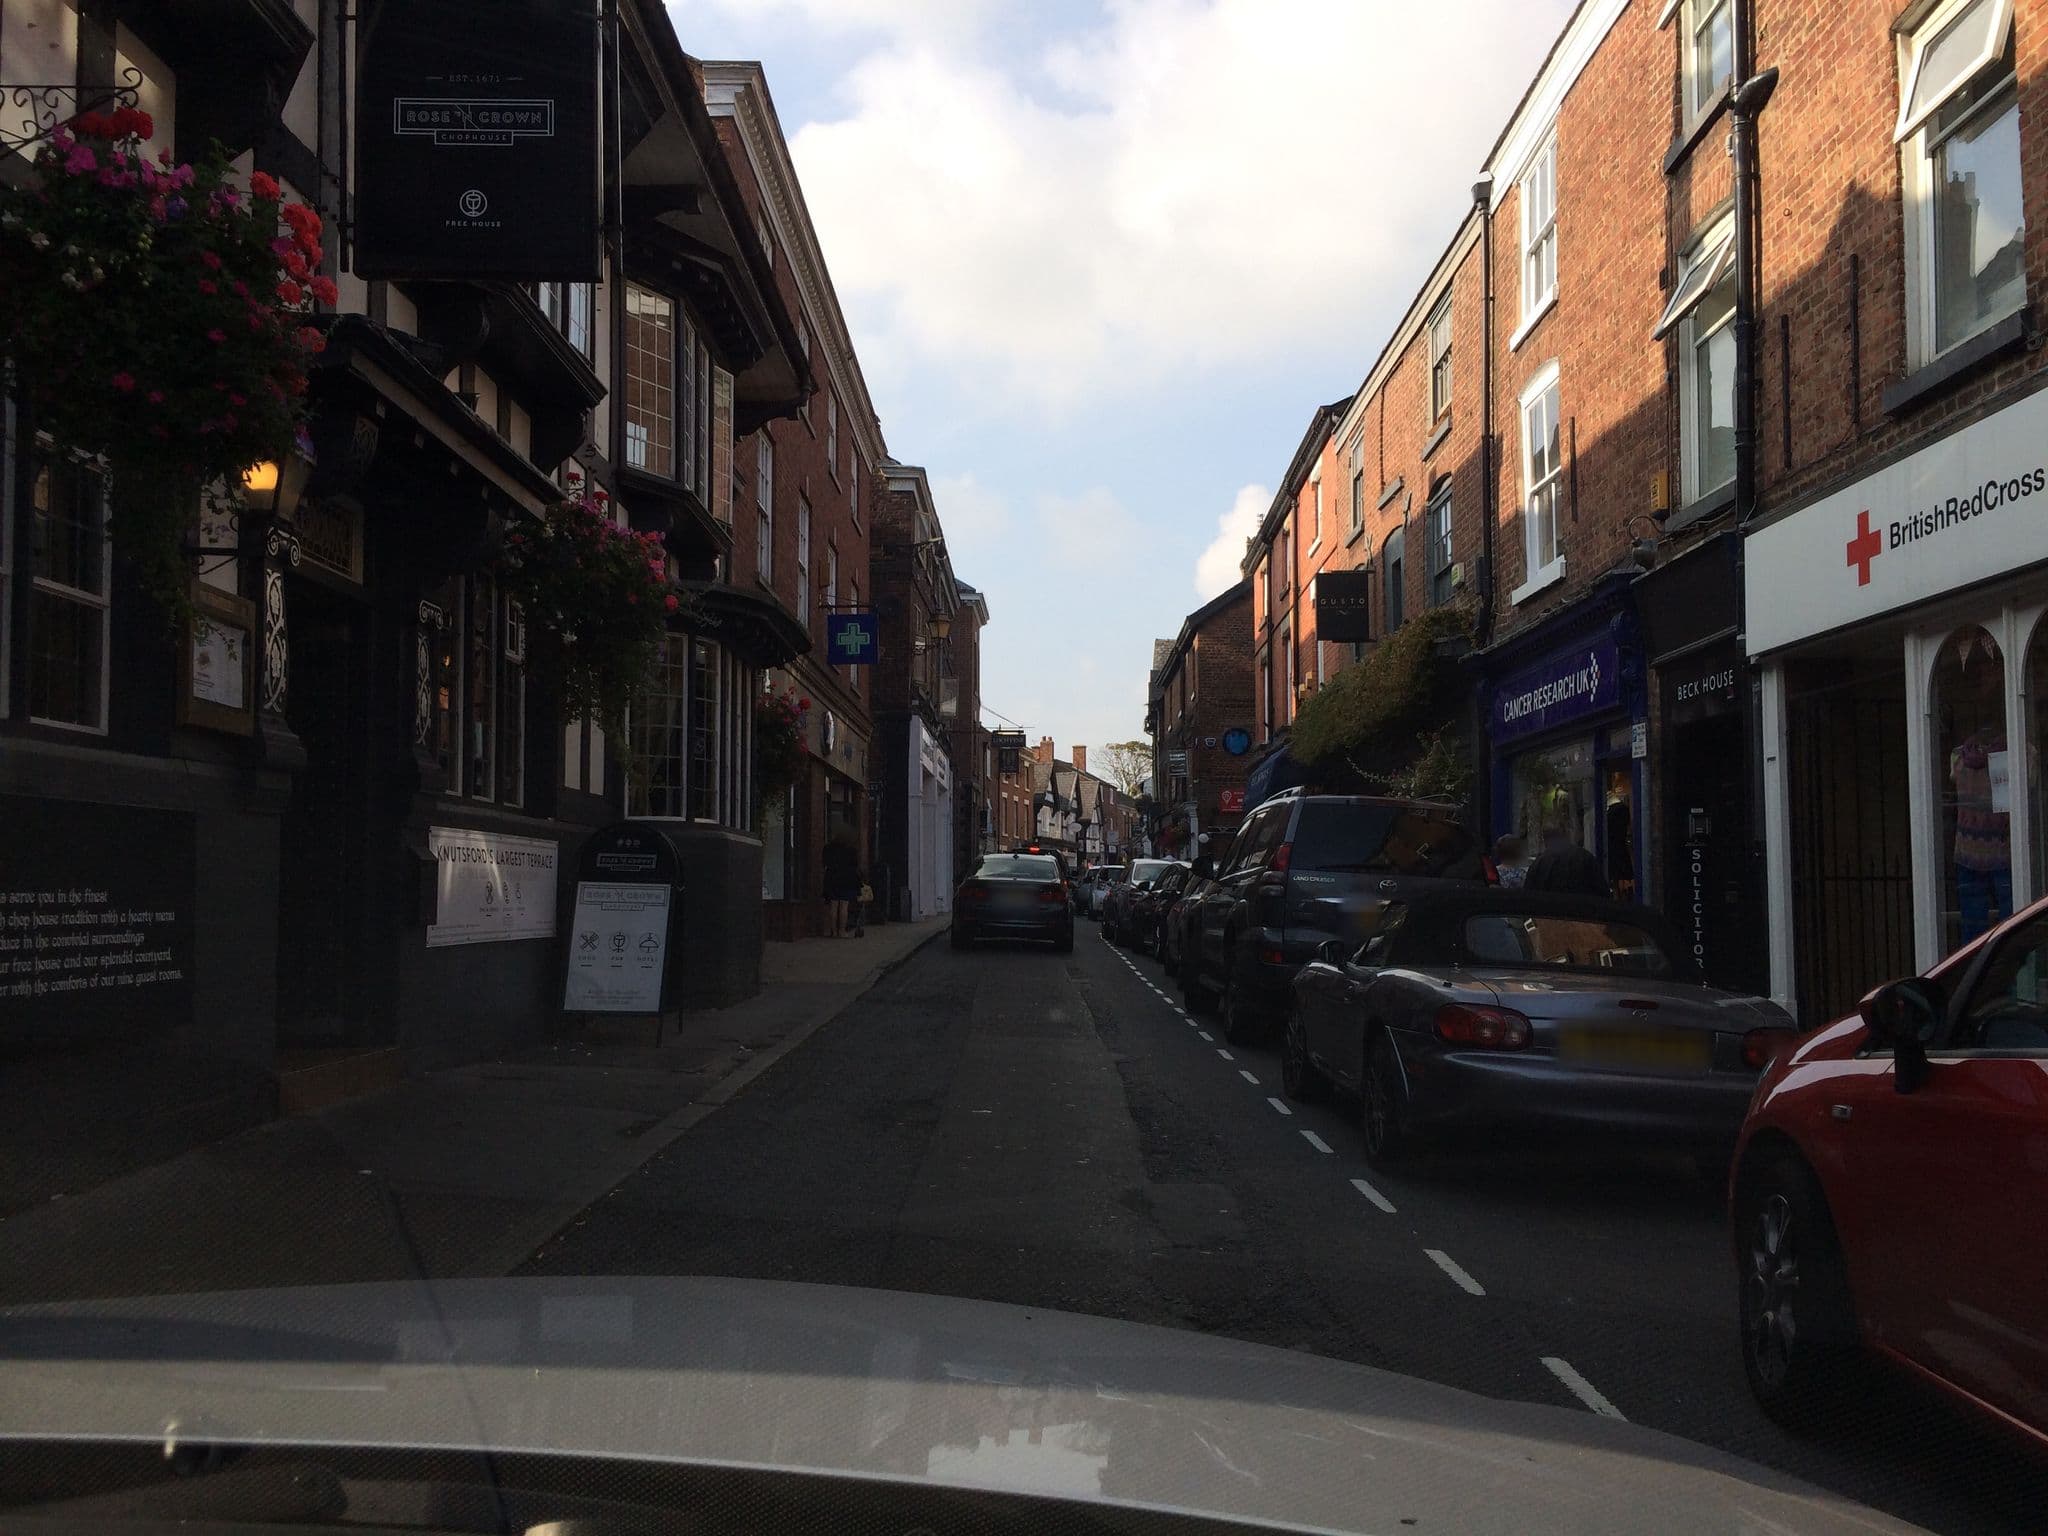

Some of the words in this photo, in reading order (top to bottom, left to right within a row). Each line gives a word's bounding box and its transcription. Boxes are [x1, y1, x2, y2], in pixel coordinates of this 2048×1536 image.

[407, 111, 450, 123] ROSE
[478, 111, 542, 124] CROWN
[441, 133, 508, 142] CHOPHOUSE
[445, 219, 468, 228] FREE
[471, 219, 502, 228] HOUSE
[1889, 467, 2046, 550] BritishRedCross
[1503, 692, 1534, 723] CANCER
[1534, 674, 1575, 711] RESEARCH
[1576, 667, 1590, 694] UK
[1676, 681, 1700, 701] BECK
[1702, 669, 1735, 694] HOUSE
[436, 844, 495, 864] KNUTSFORD'S
[496, 849, 525, 866] LARGEST
[38, 892, 55, 907] you
[57, 889, 67, 903] in
[69, 888, 82, 906] the
[7, 912, 30, 929] chop
[33, 912, 59, 929] house
[61, 910, 98, 925] tradition
[100, 910, 118, 926] with
[120, 911, 126, 923] a
[128, 909, 153, 926] hearty
[23, 936, 33, 949] in
[35, 933, 49, 951] the
[91, 930, 145, 947] surroundings
[12, 956, 32, 973] free
[35, 955, 61, 974] house
[64, 953, 82, 969] and
[84, 955, 99, 968] our
[100, 950, 133, 968] splendid
[11, 979, 32, 997] with
[34, 978, 48, 996] the
[89, 973, 99, 988] of
[100, 974, 116, 987] our
